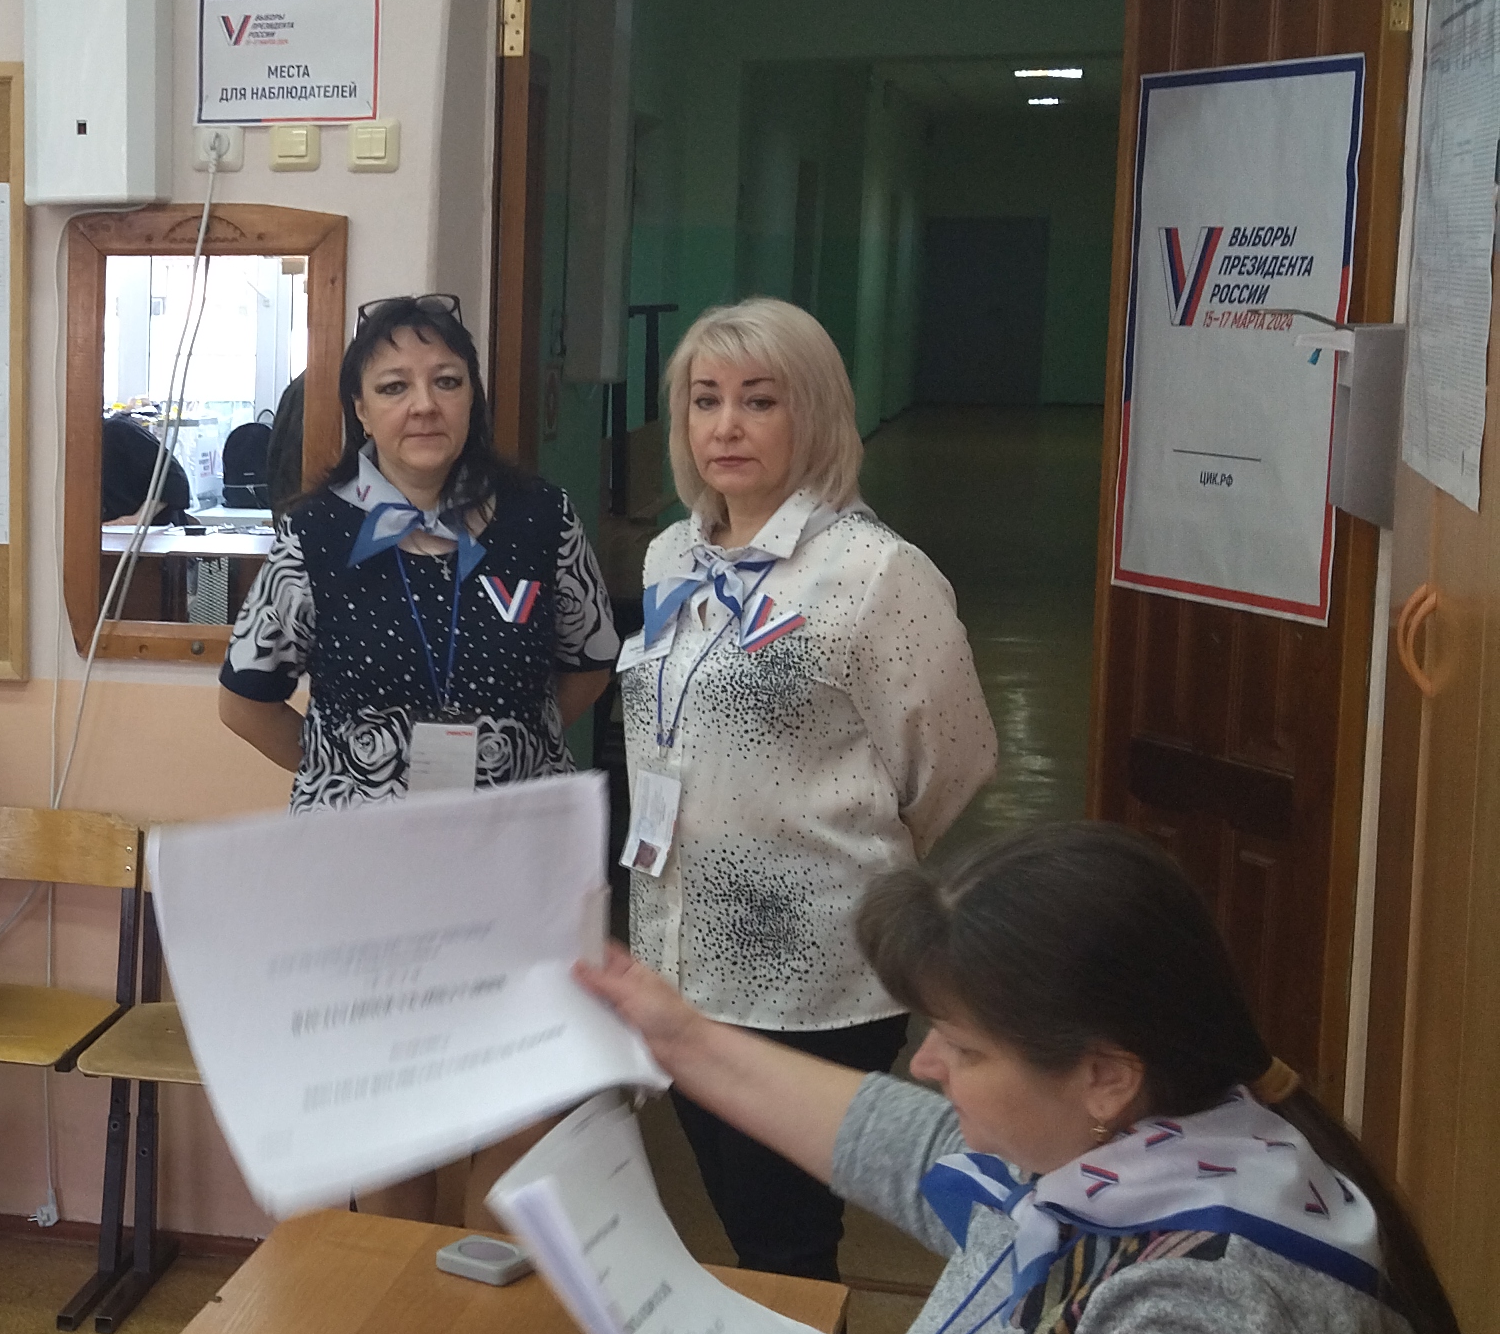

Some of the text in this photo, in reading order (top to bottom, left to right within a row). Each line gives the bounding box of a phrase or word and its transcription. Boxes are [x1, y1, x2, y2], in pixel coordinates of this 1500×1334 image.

[268, 65, 310, 79] МЕСТА
[219, 82, 357, 102] ДЛЯ НАБЛЮДАТЕЛЕЙ
[1228, 226, 1297, 247] ВЫБОРЫ
[1218, 255, 1314, 279] ПРЕЗИДЕНТА
[1209, 284, 1270, 304] РОССИИ
[1231, 311, 1265, 330] МАРТА
[1266, 312, 1293, 331] 2024
[1200, 471, 1233, 487] ЦИК.РФ
